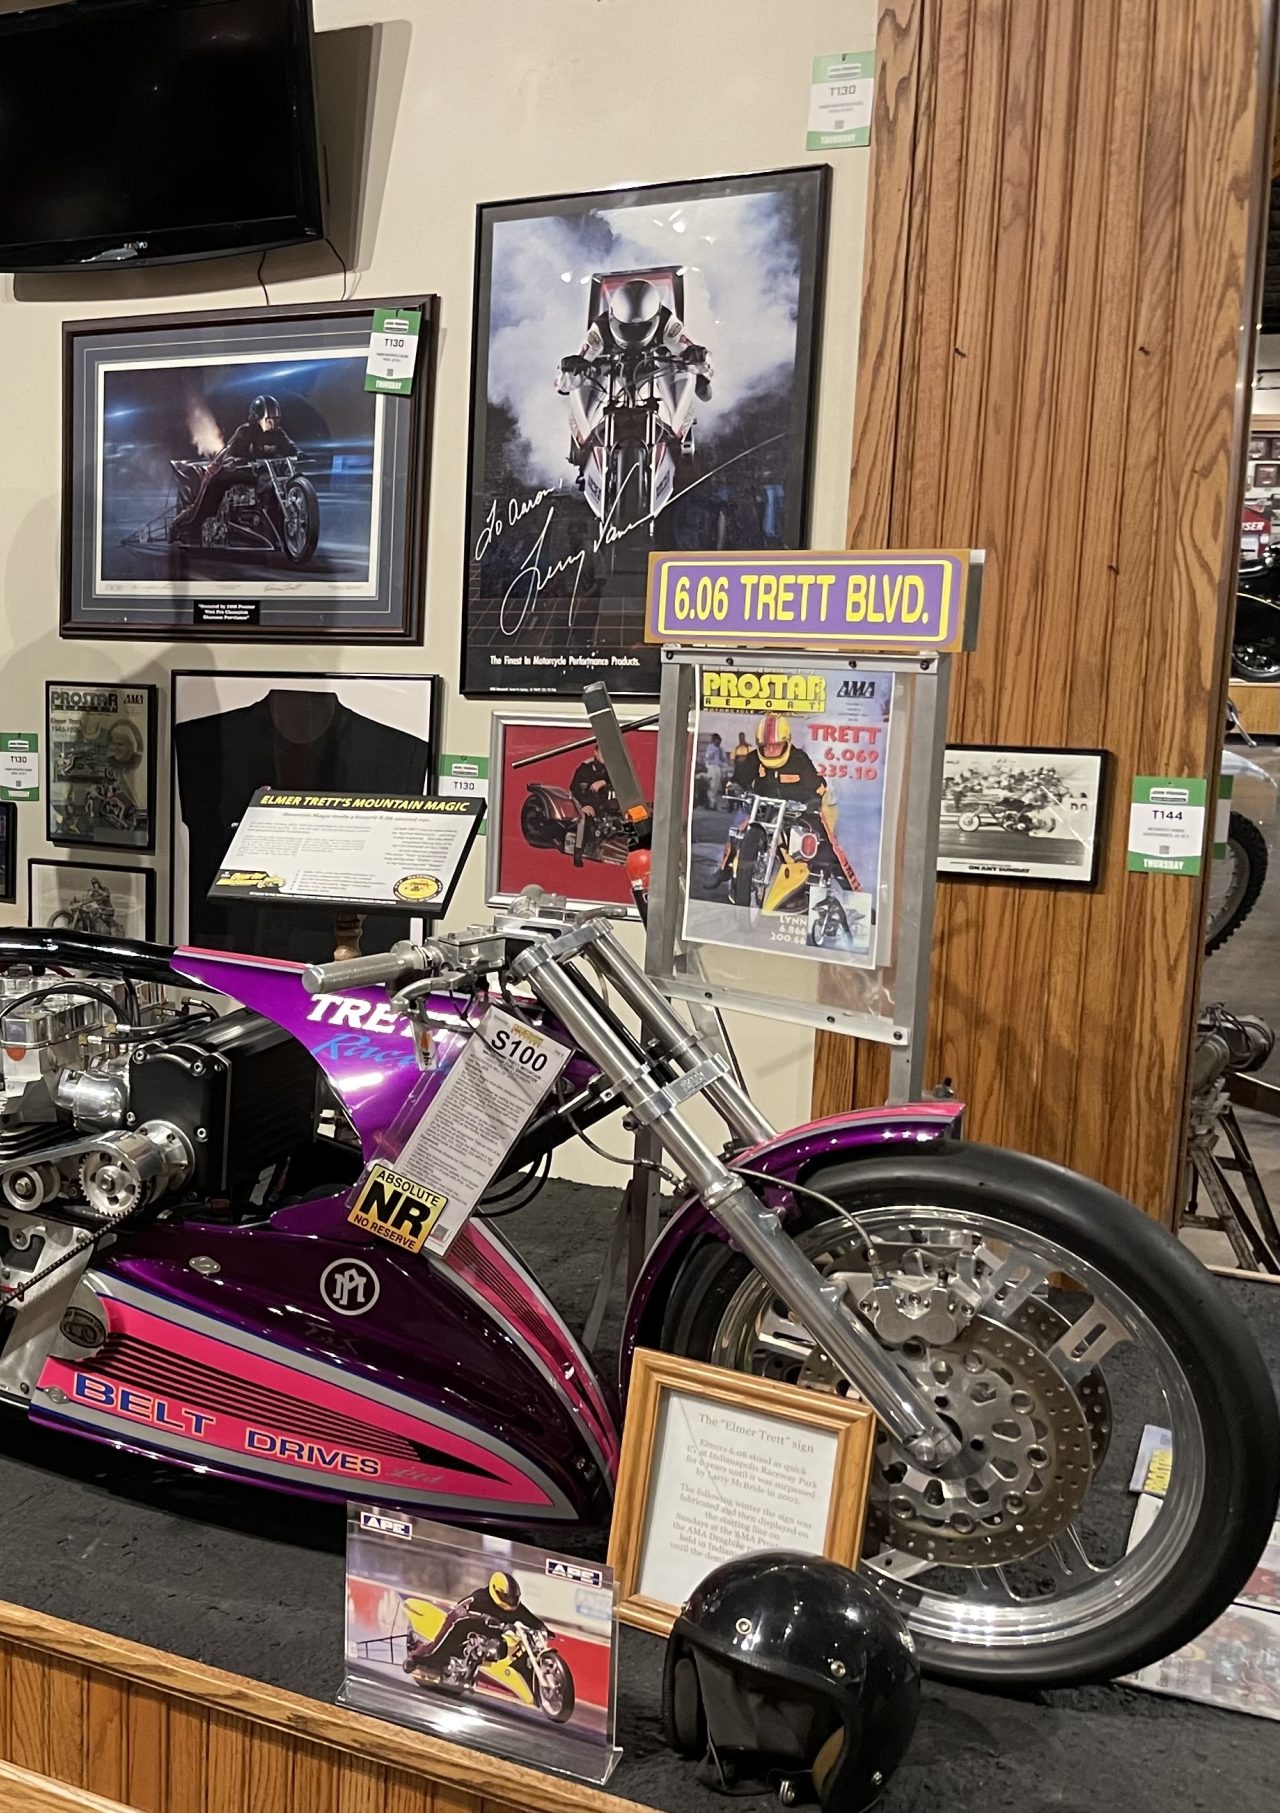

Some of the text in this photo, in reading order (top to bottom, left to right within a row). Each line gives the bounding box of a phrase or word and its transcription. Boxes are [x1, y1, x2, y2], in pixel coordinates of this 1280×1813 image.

[829, 85, 856, 97] T130
[384, 338, 404, 348] T130
[673, 574, 929, 624] 6.06 TRETT BLVD.
[489, 655, 641, 667] The Finest In Motorcycle Performance Products.
[702, 672, 875, 701] PROSTAR AMA
[50, 691, 144, 706] PROSTAR AMA
[705, 698, 816, 711] REPORT
[807, 723, 882, 745] TRETT
[10, 755, 28, 764] T130
[823, 748, 879, 763] 6.069
[816, 764, 878, 781] 235.10
[453, 781, 475, 791] T130
[260, 794, 470, 812] ELMER TRETT'S MOUNTAIN MAGIC
[1151, 809, 1184, 822] T144
[1142, 858, 1184, 871] THURSDAY
[779, 915, 808, 926] LYNN
[491, 1029, 548, 1072] S100
[377, 1169, 440, 1207] ABSOLUTE
[359, 1180, 432, 1239] NR
[353, 1214, 417, 1250] NO RESERVE
[74, 1372, 380, 1477] BELT DRIVES
[699, 1413, 718, 1426] The
[792, 1439, 814, 1454] sign
[686, 1455, 697, 1465] for
[728, 1467, 748, 1479] until
[757, 1476, 773, 1486] was
[709, 1451, 759, 1472] Indianapolis
[761, 1468, 796, 1483] Raceway
[799, 1477, 817, 1489] Park
[749, 1453, 771, 1465] stood
[783, 1463, 806, 1475] quick
[696, 1467, 705, 1477] by
[731, 1477, 765, 1493] McBride
[767, 1488, 775, 1497] in
[680, 1483, 694, 1494] The
[735, 1499, 761, 1514] winter
[763, 1506, 776, 1518] the
[778, 1513, 794, 1525] sign
[796, 1520, 812, 1529] was
[680, 1494, 809, 1539] fabricated and then displayed on
[364, 1515, 408, 1538] APE
[672, 1521, 744, 1550] the AMA Dragbike
[675, 1512, 755, 1543] Sundays at the AMA
[705, 1511, 780, 1540] the starting line on
[670, 1542, 703, 1557] until the
[679, 1533, 705, 1546] held in
[551, 1561, 600, 1584] APE
